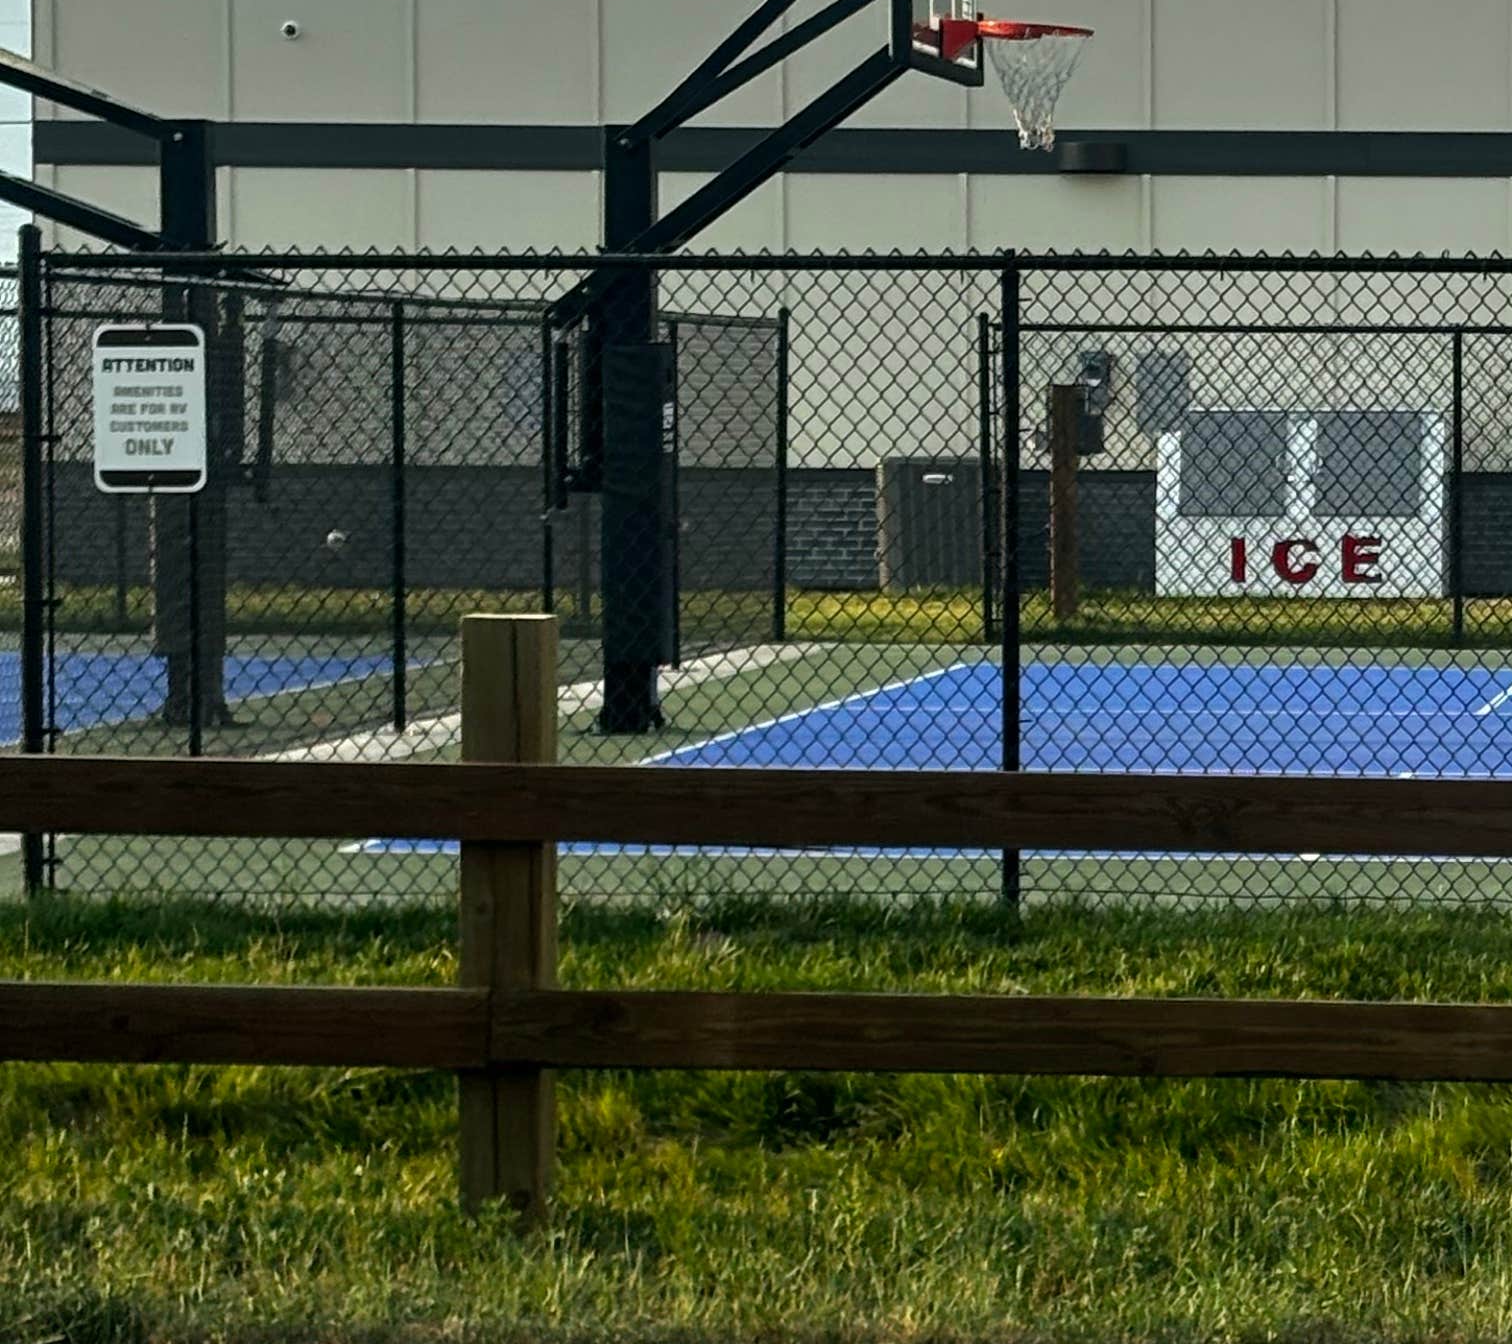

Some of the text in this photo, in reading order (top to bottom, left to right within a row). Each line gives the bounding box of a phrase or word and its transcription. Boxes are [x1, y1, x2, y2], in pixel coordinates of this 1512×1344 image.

[102, 358, 195, 373] ATTENTION
[113, 386, 184, 397] AMENITIES
[111, 403, 188, 415] ARE FOR RV
[109, 421, 189, 433] CUSTOMERS
[125, 438, 174, 456] ONLY
[1231, 532, 1383, 584] ICE
